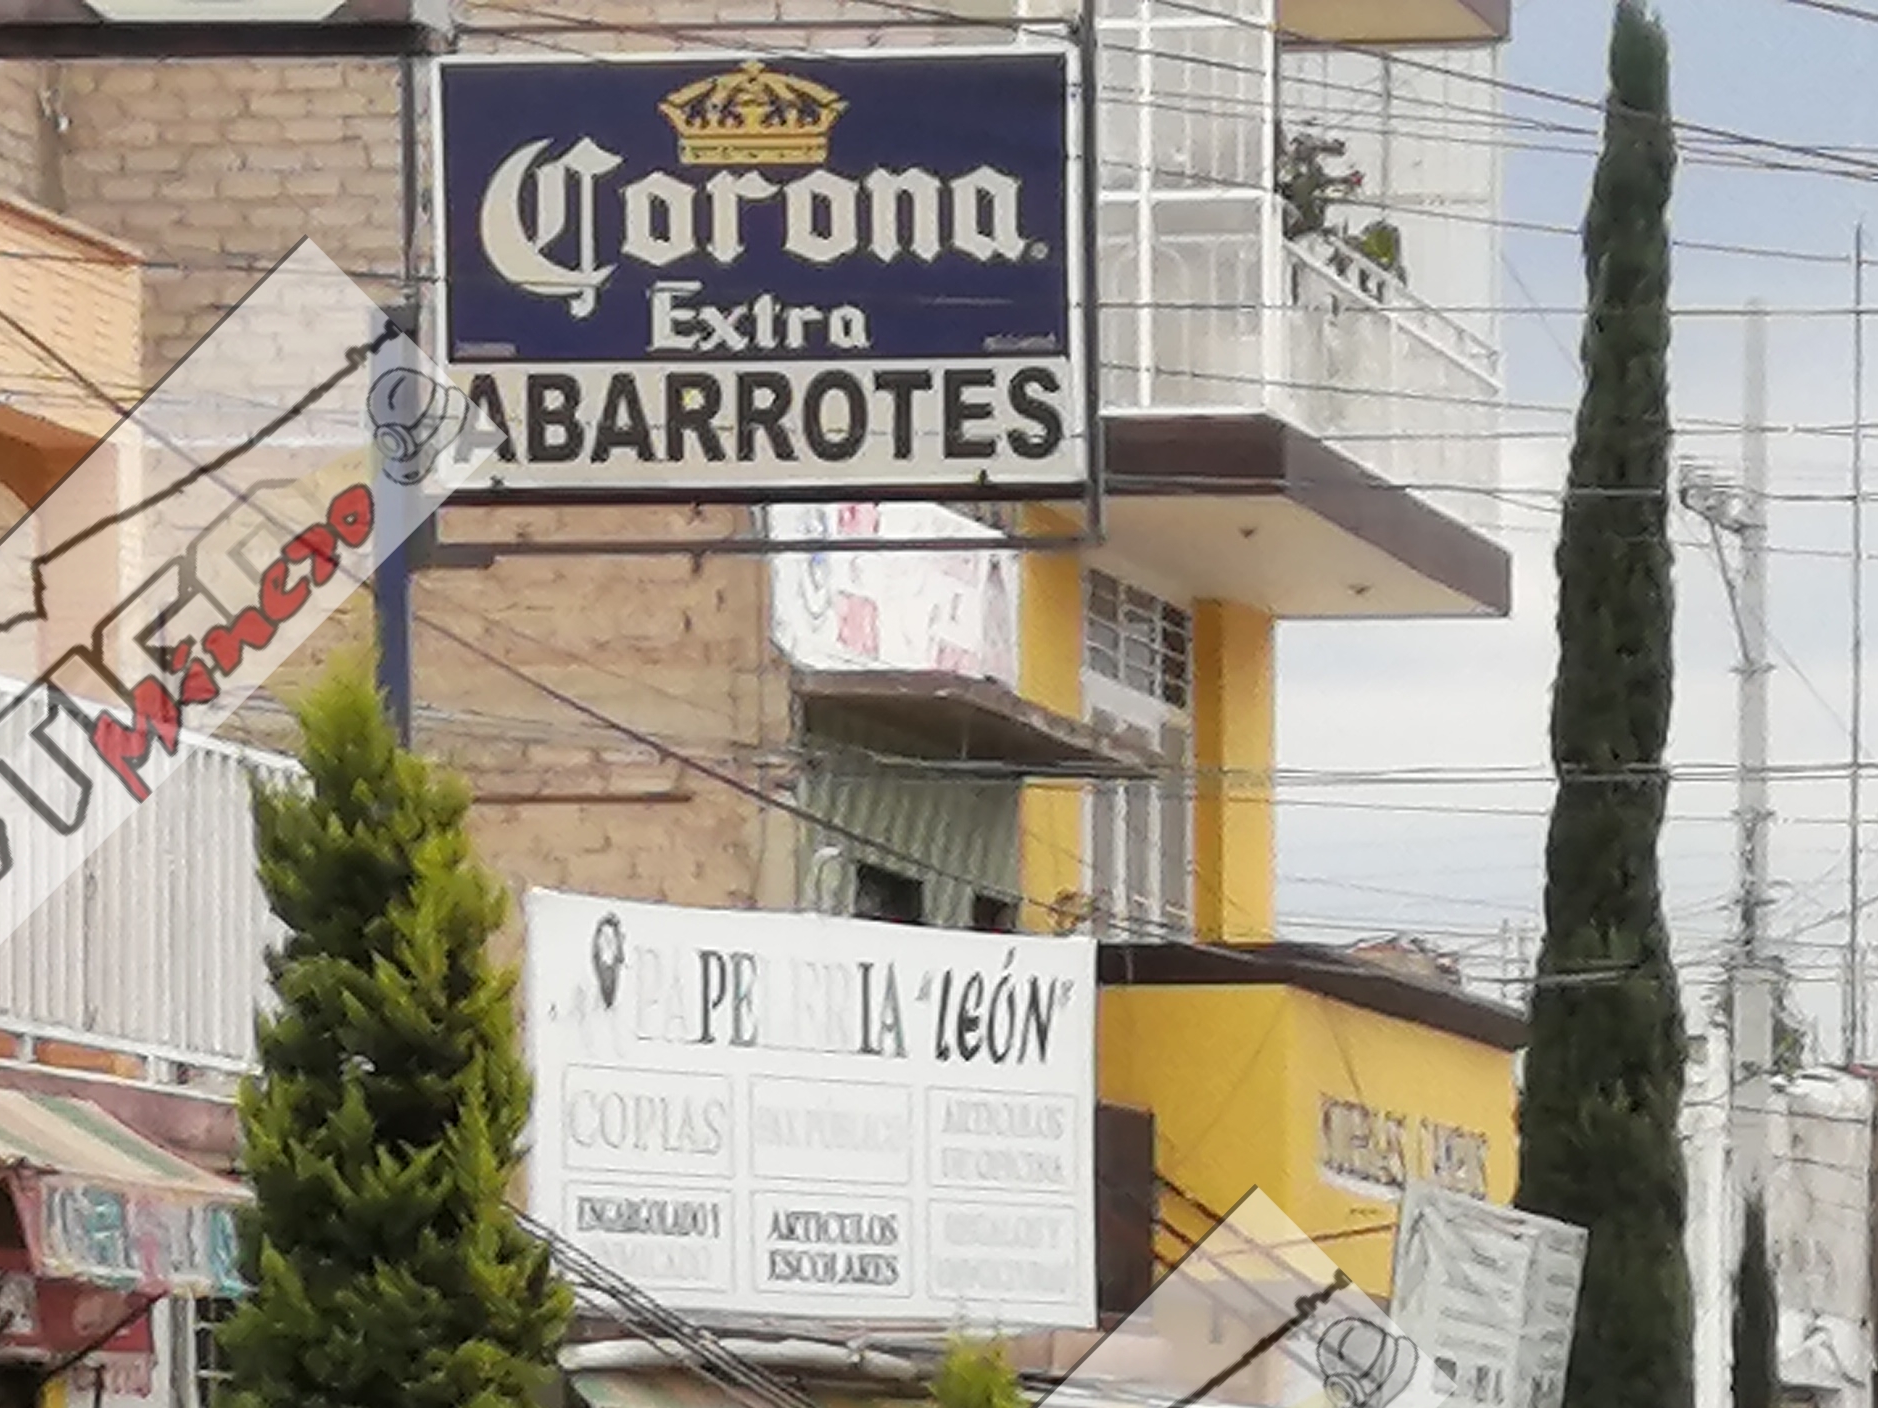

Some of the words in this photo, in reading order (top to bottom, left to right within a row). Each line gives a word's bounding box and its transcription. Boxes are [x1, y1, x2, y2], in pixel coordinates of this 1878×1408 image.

[480, 135, 1029, 320] Corona
[647, 280, 872, 353] Extra
[452, 366, 1064, 464] ABARROTES
[568, 1087, 728, 1157] COPIAS
